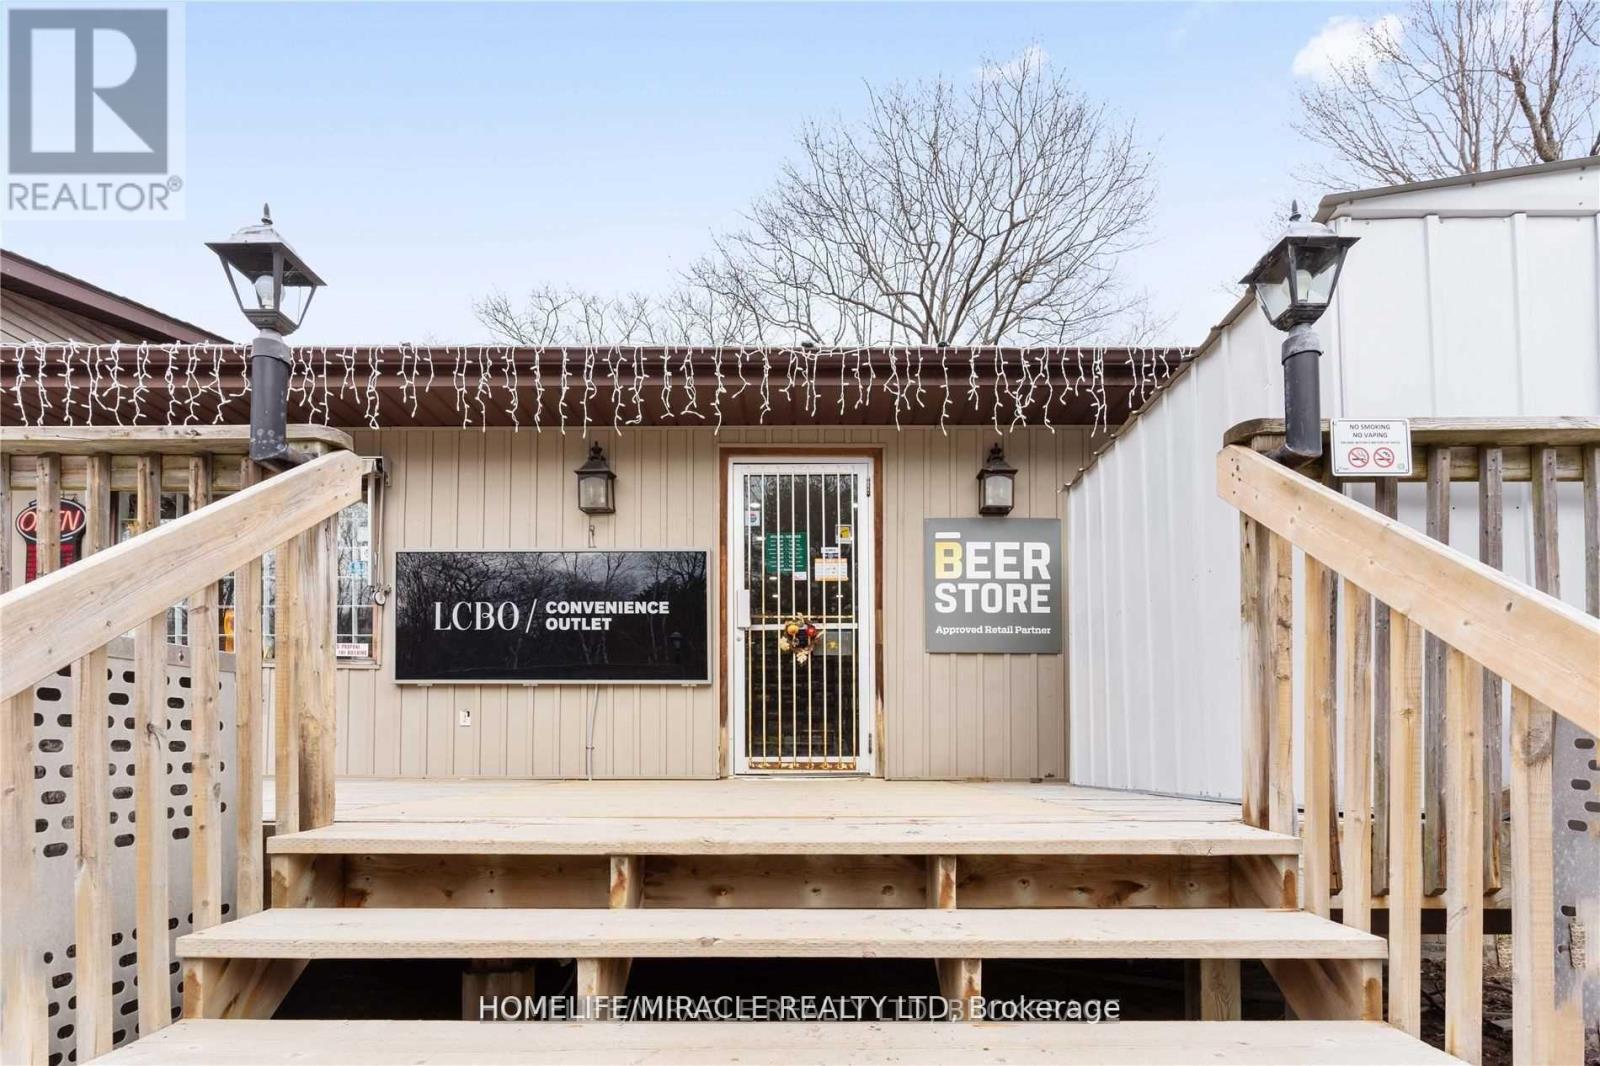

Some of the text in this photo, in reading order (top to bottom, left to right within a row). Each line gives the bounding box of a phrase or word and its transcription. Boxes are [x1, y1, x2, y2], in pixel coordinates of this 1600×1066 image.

[20, 510, 80, 531] ON
[934, 541, 1051, 580] BEER
[545, 601, 670, 615] CONVENIENCE
[934, 582, 1051, 614] STORE
[433, 601, 520, 631] LCBO
[545, 617, 612, 631] OUTLET
[935, 625, 1052, 636] Approved Retail Partner
